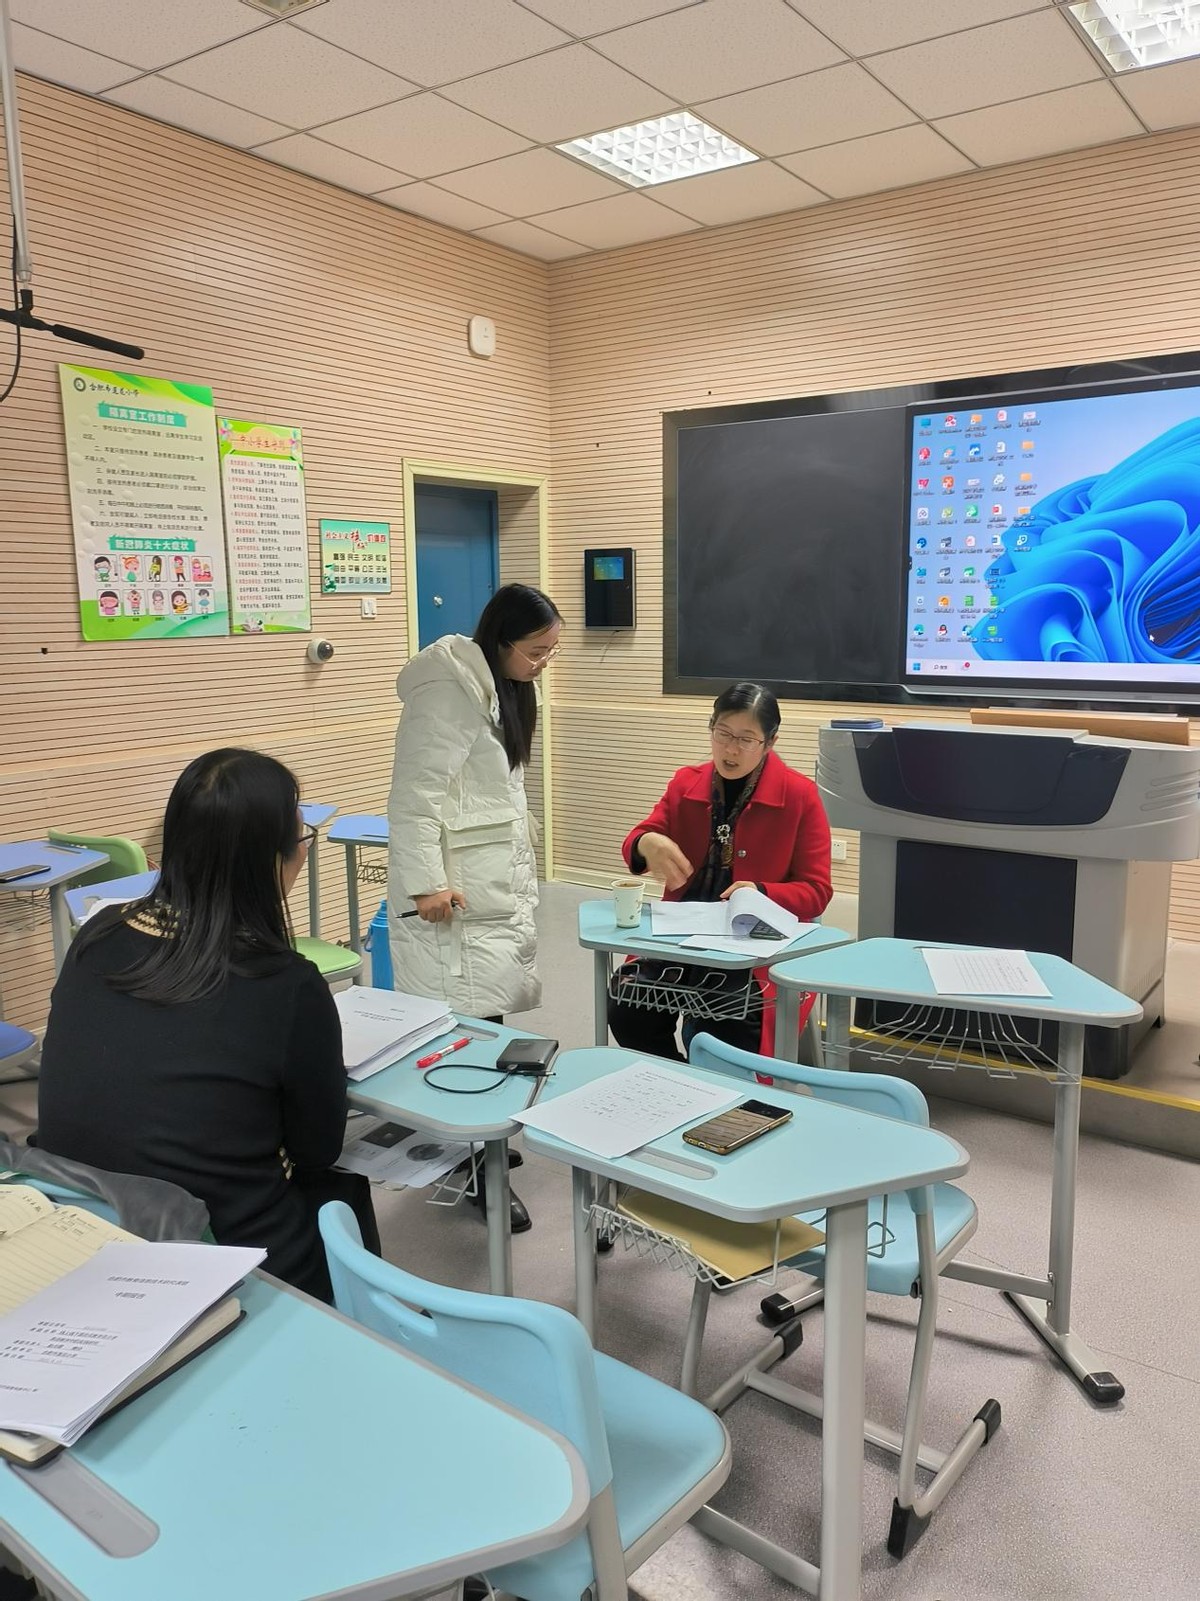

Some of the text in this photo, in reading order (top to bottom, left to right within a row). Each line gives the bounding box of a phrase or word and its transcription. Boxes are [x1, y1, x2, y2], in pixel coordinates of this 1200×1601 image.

[115, 539, 189, 551] 新冠肺炎十大症状
